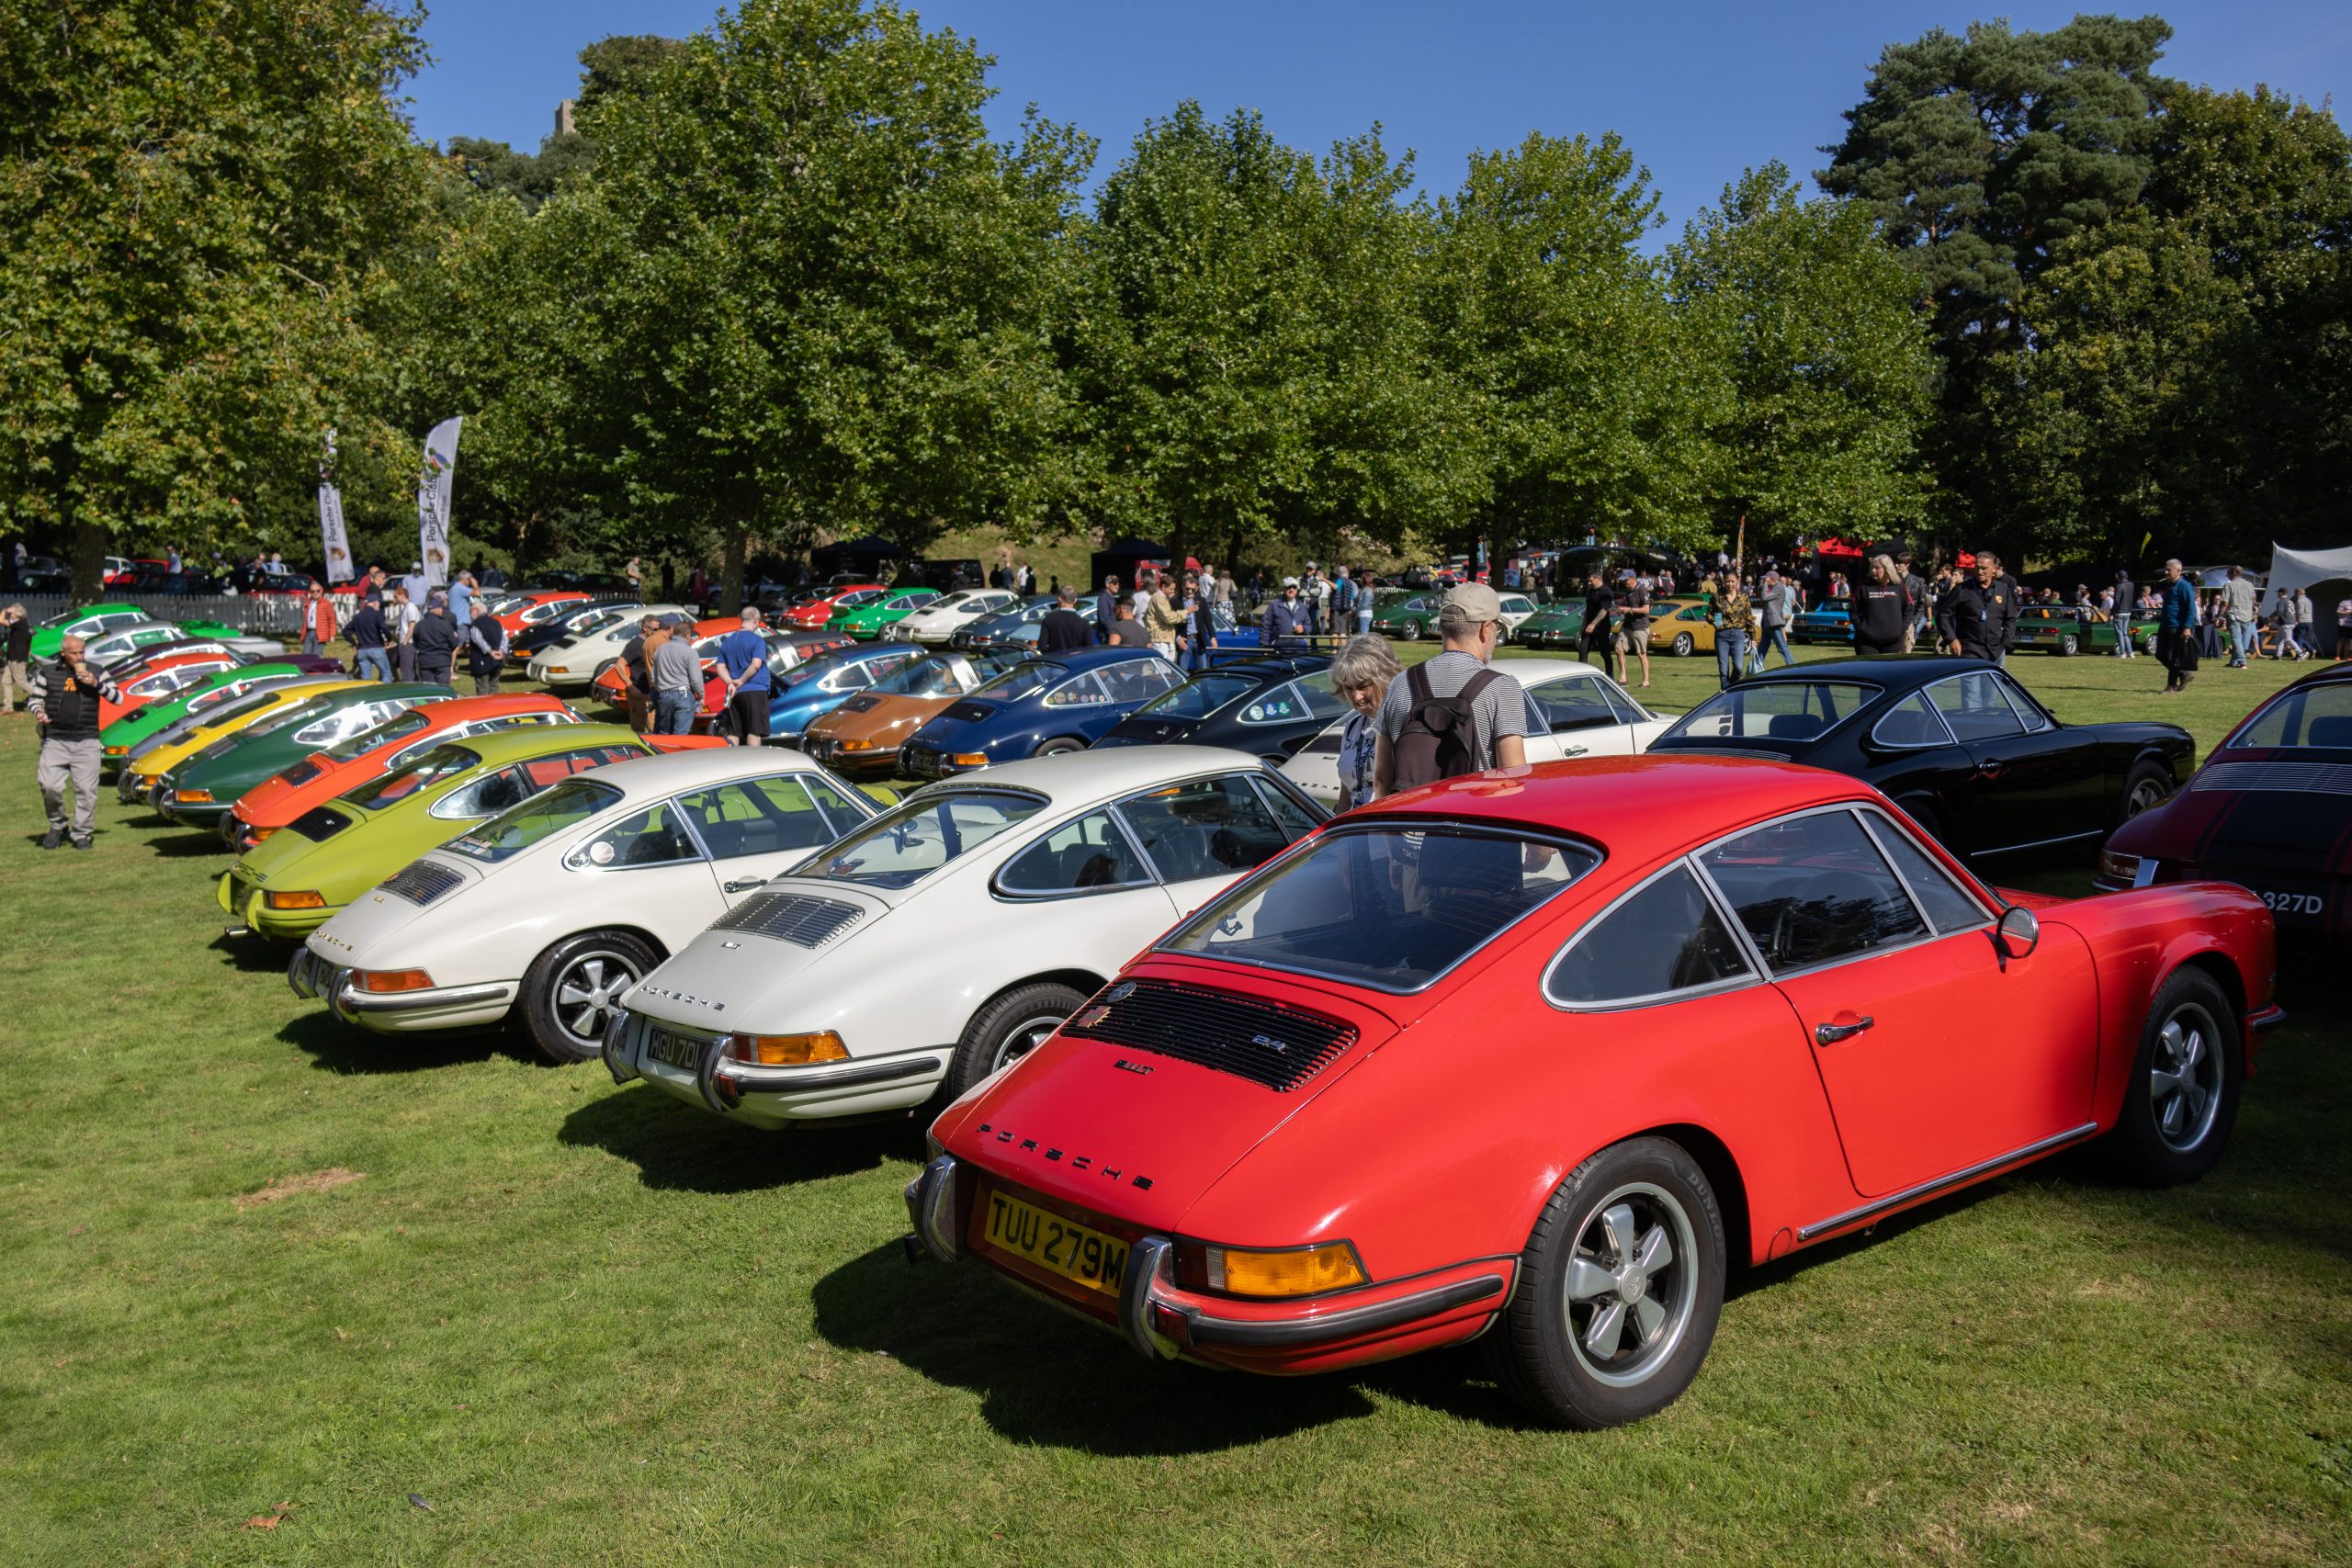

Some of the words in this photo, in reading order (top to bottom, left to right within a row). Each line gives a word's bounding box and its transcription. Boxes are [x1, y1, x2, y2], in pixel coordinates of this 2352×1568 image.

[426, 501, 436, 542] Porsce
[2263, 891, 2324, 915] 327D
[978, 1123, 1155, 1190] PORSCHE
[992, 1197, 1041, 1252] TUU
[1044, 1222, 1125, 1290] 279M
